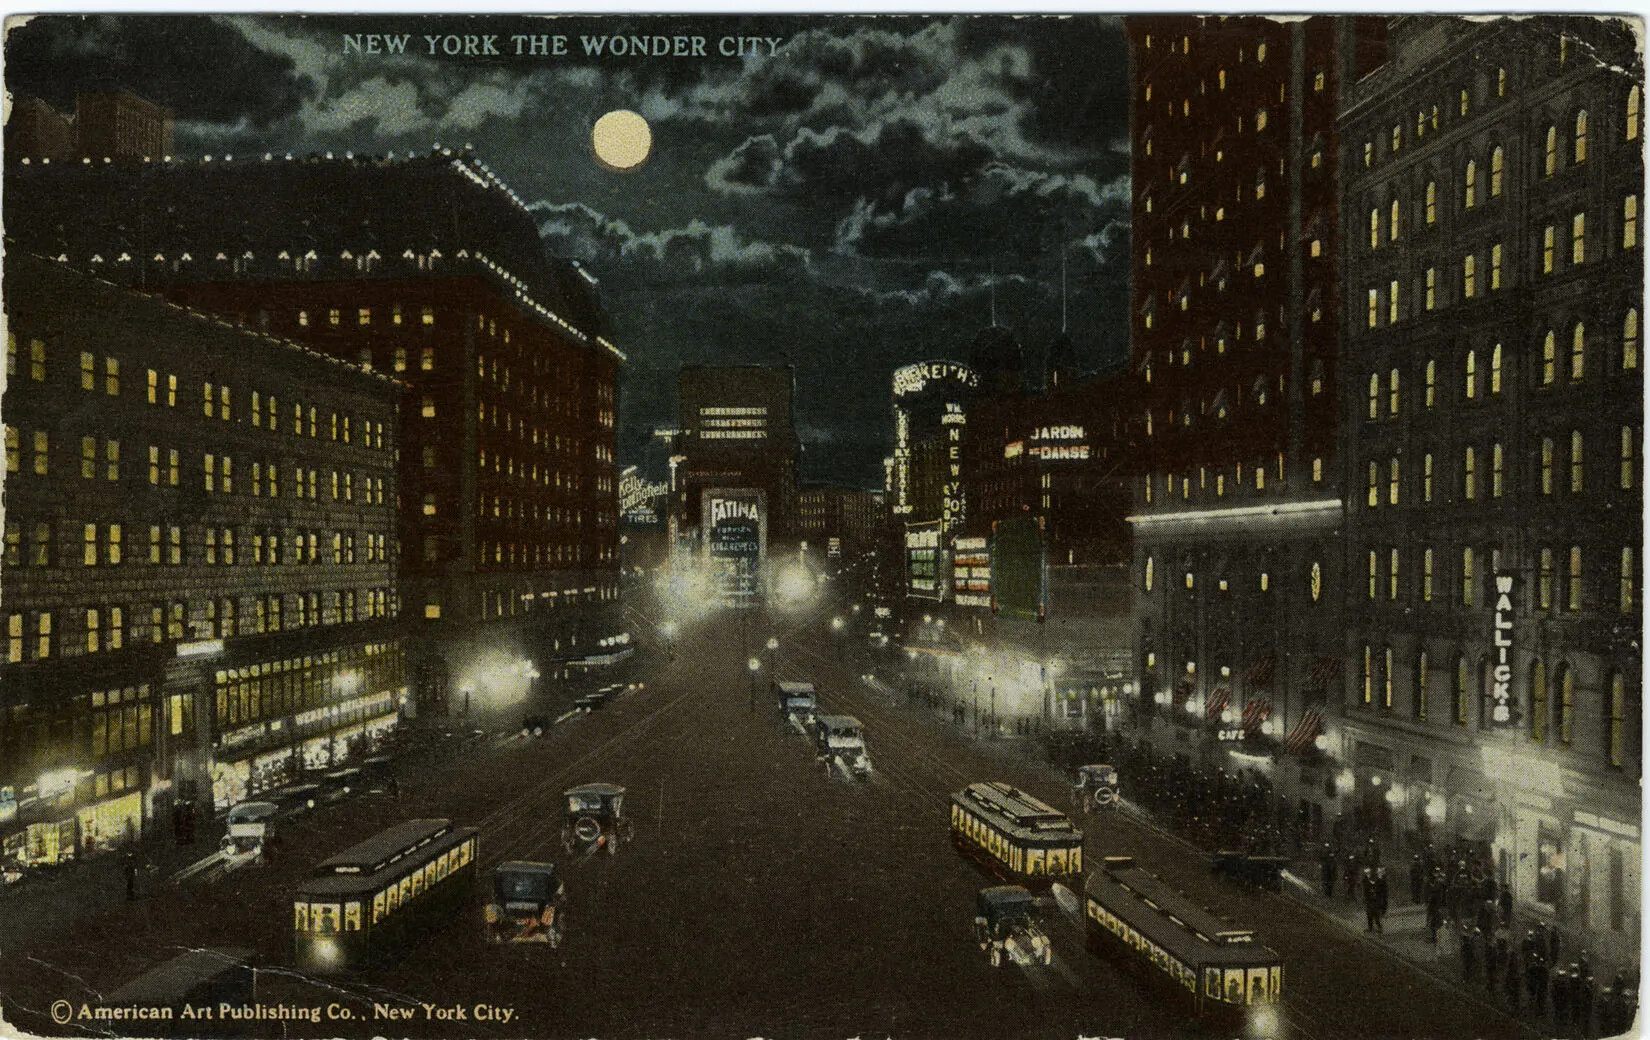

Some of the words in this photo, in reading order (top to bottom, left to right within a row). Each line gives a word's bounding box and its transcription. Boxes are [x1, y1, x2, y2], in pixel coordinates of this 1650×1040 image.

[1030, 425, 1084, 440] JARDIN
[1040, 446, 1090, 460] DANSE
[627, 515, 658, 523] TIRES
[711, 498, 759, 527] FATIMA
